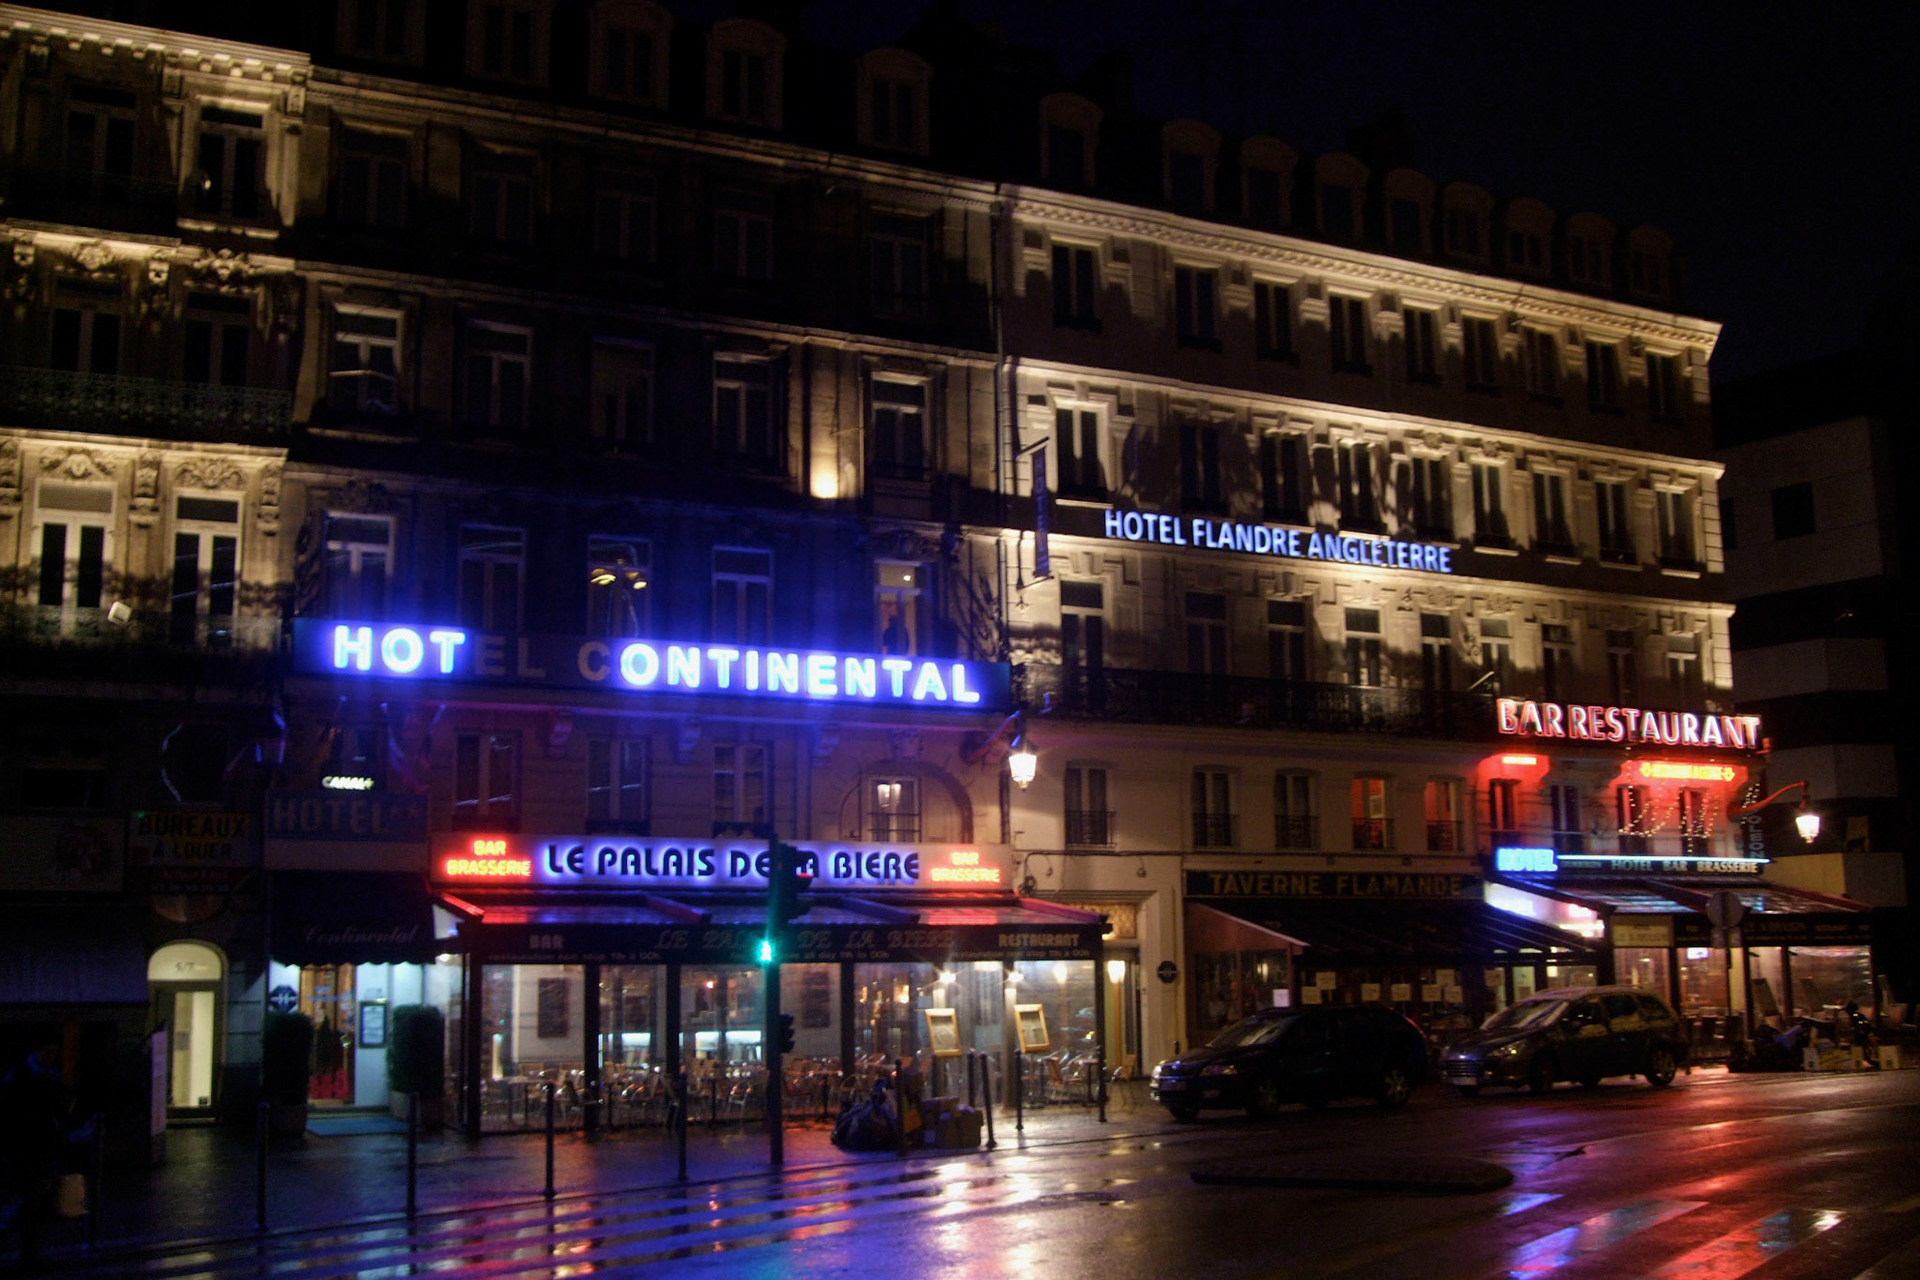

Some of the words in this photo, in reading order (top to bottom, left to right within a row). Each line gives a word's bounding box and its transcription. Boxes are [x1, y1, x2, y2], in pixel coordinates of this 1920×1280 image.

[1104, 509, 1187, 546] HOTEL
[1192, 517, 1301, 558] FLANDRE
[1307, 531, 1453, 573] ANGLETERRE
[333, 624, 546, 679] HOTEL
[577, 640, 981, 704] CONTINENTAL
[1496, 698, 1567, 739] BAR
[1567, 704, 1761, 750] RESTAURANT
[138, 814, 245, 837] BUREAUX
[273, 799, 388, 833] HOTEL
[473, 840, 507, 856] BAR
[951, 852, 979, 865] BAR
[446, 859, 532, 877] BRASSERIE
[548, 845, 584, 874] LE
[598, 848, 716, 876] PALAIS
[730, 850, 771, 878] DE
[834, 853, 919, 879] BIERE
[1498, 848, 1558, 872] HOTEL
[1611, 860, 1653, 872] HOTEL
[1663, 861, 1687, 872] BAR
[1696, 862, 1759, 874] BRASSERIE
[1209, 873, 1321, 896] TAVERNE
[1336, 874, 1462, 896] FLAMANDE
[528, 934, 565, 950] BAR
[998, 933, 1080, 948] RESTAURANT
